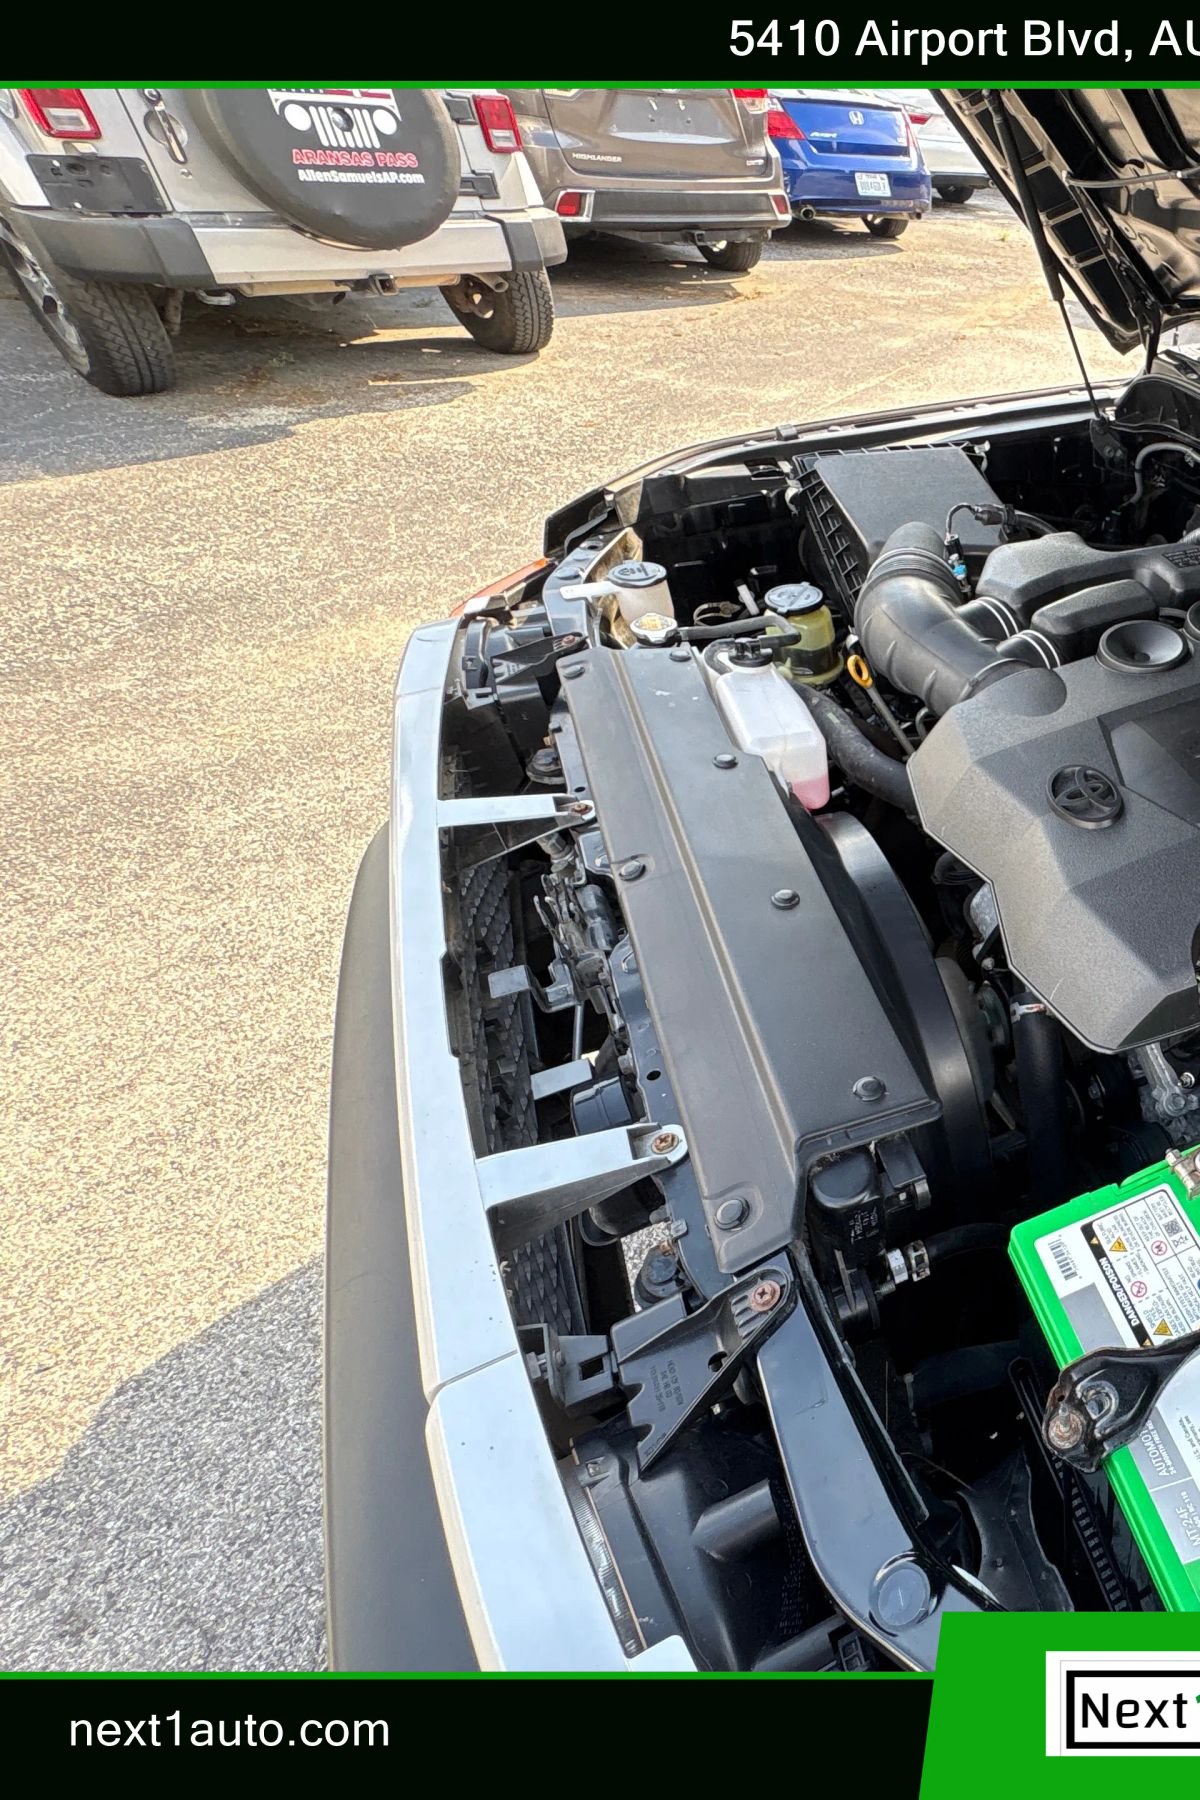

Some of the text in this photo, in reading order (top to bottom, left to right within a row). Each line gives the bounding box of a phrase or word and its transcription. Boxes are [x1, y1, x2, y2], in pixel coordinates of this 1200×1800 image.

[292, 149, 418, 168] ARANSAS PASS
[298, 169, 425, 184] AllenSamuelsAP.com
[1097, 1255, 1140, 1327] DANGER/POISON
[1149, 1428, 1162, 1445] FREE
[1137, 1427, 1170, 1479] AUTOMOT
